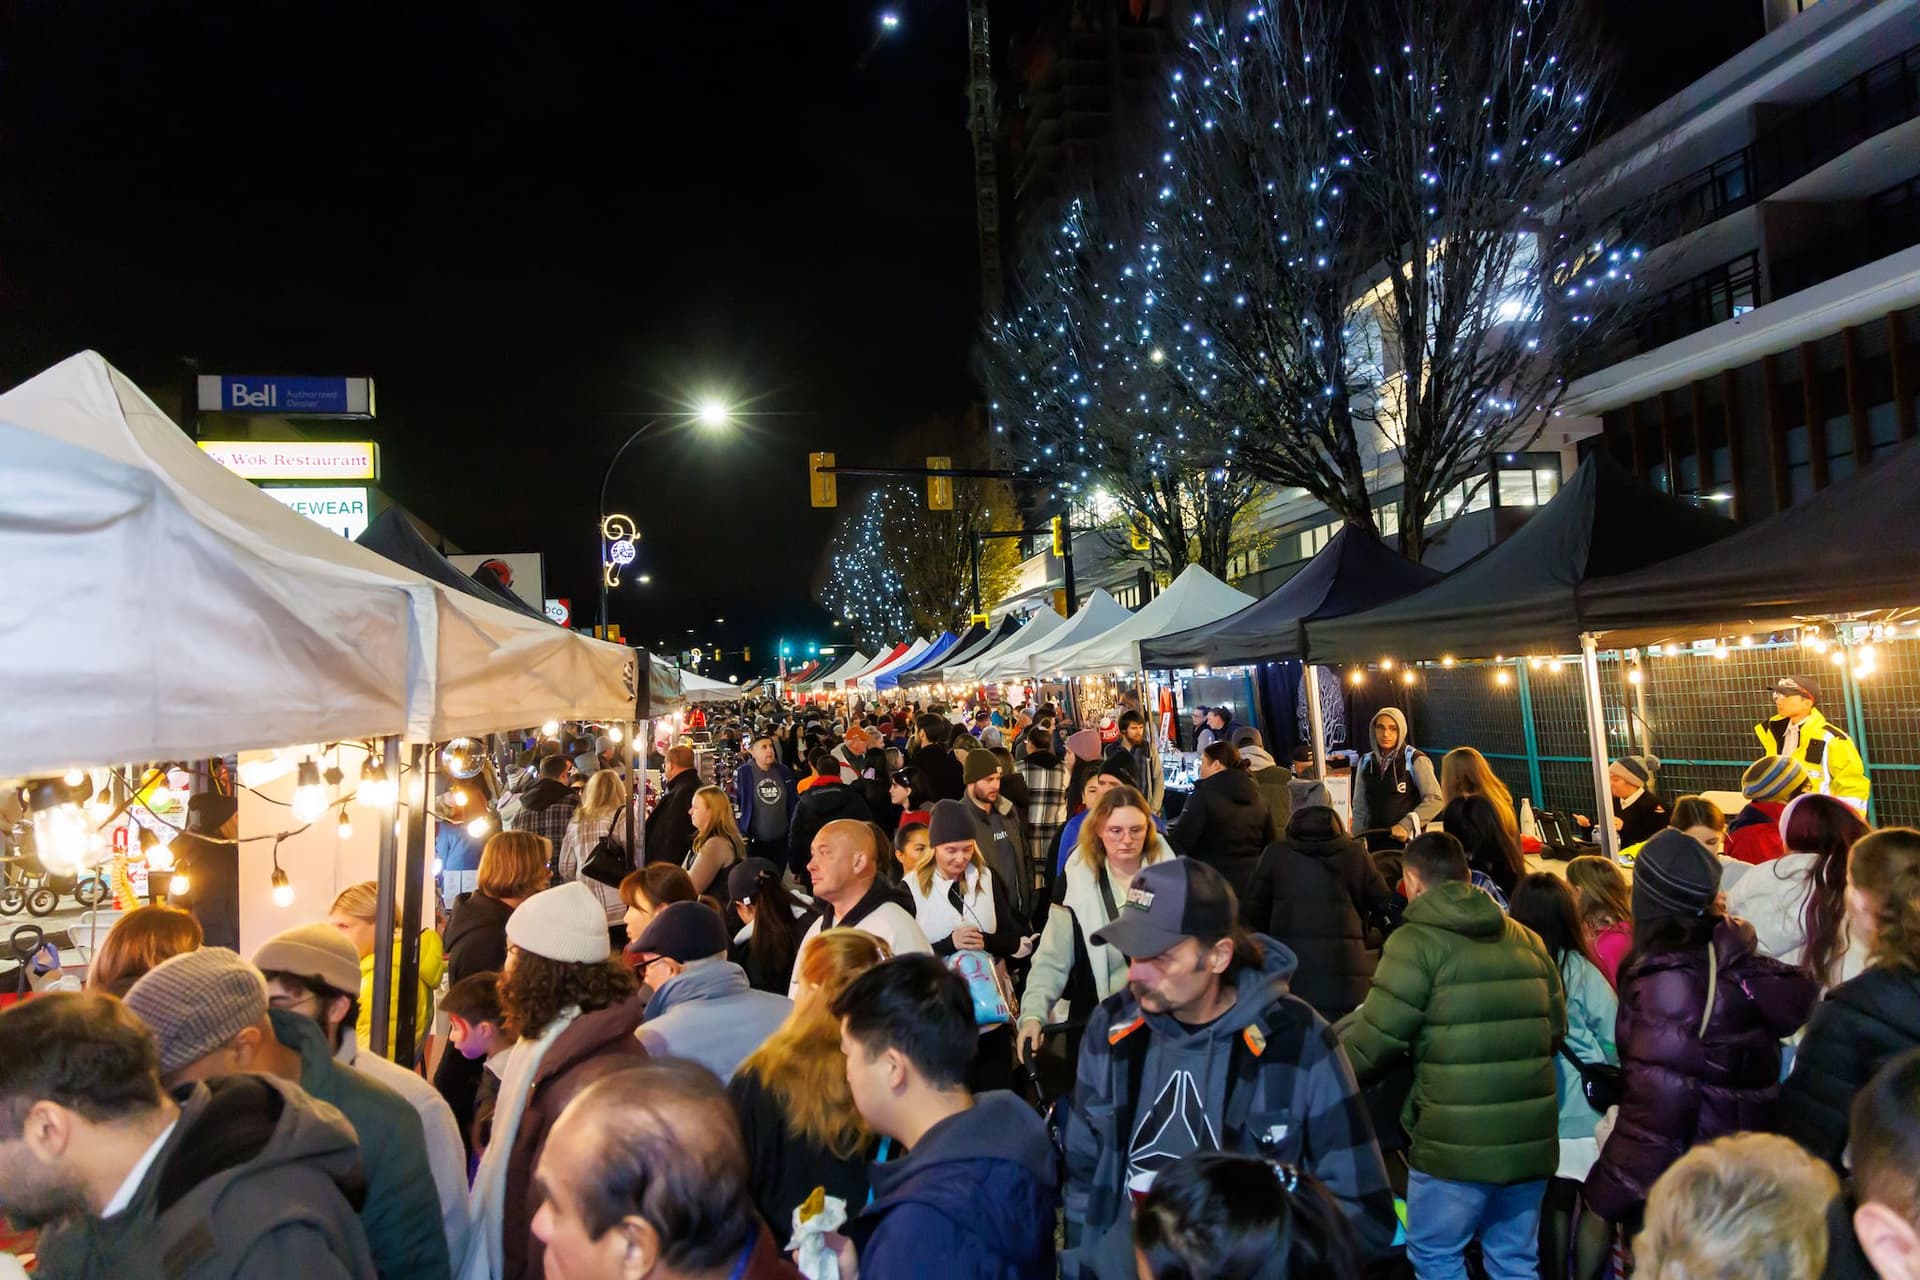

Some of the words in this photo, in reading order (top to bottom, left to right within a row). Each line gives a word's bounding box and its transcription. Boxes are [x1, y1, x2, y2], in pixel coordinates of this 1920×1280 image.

[232, 384, 277, 407] Bell
[231, 453, 267, 465] Wok
[274, 454, 369, 466] Restaurant
[290, 501, 364, 515] EWEAR
